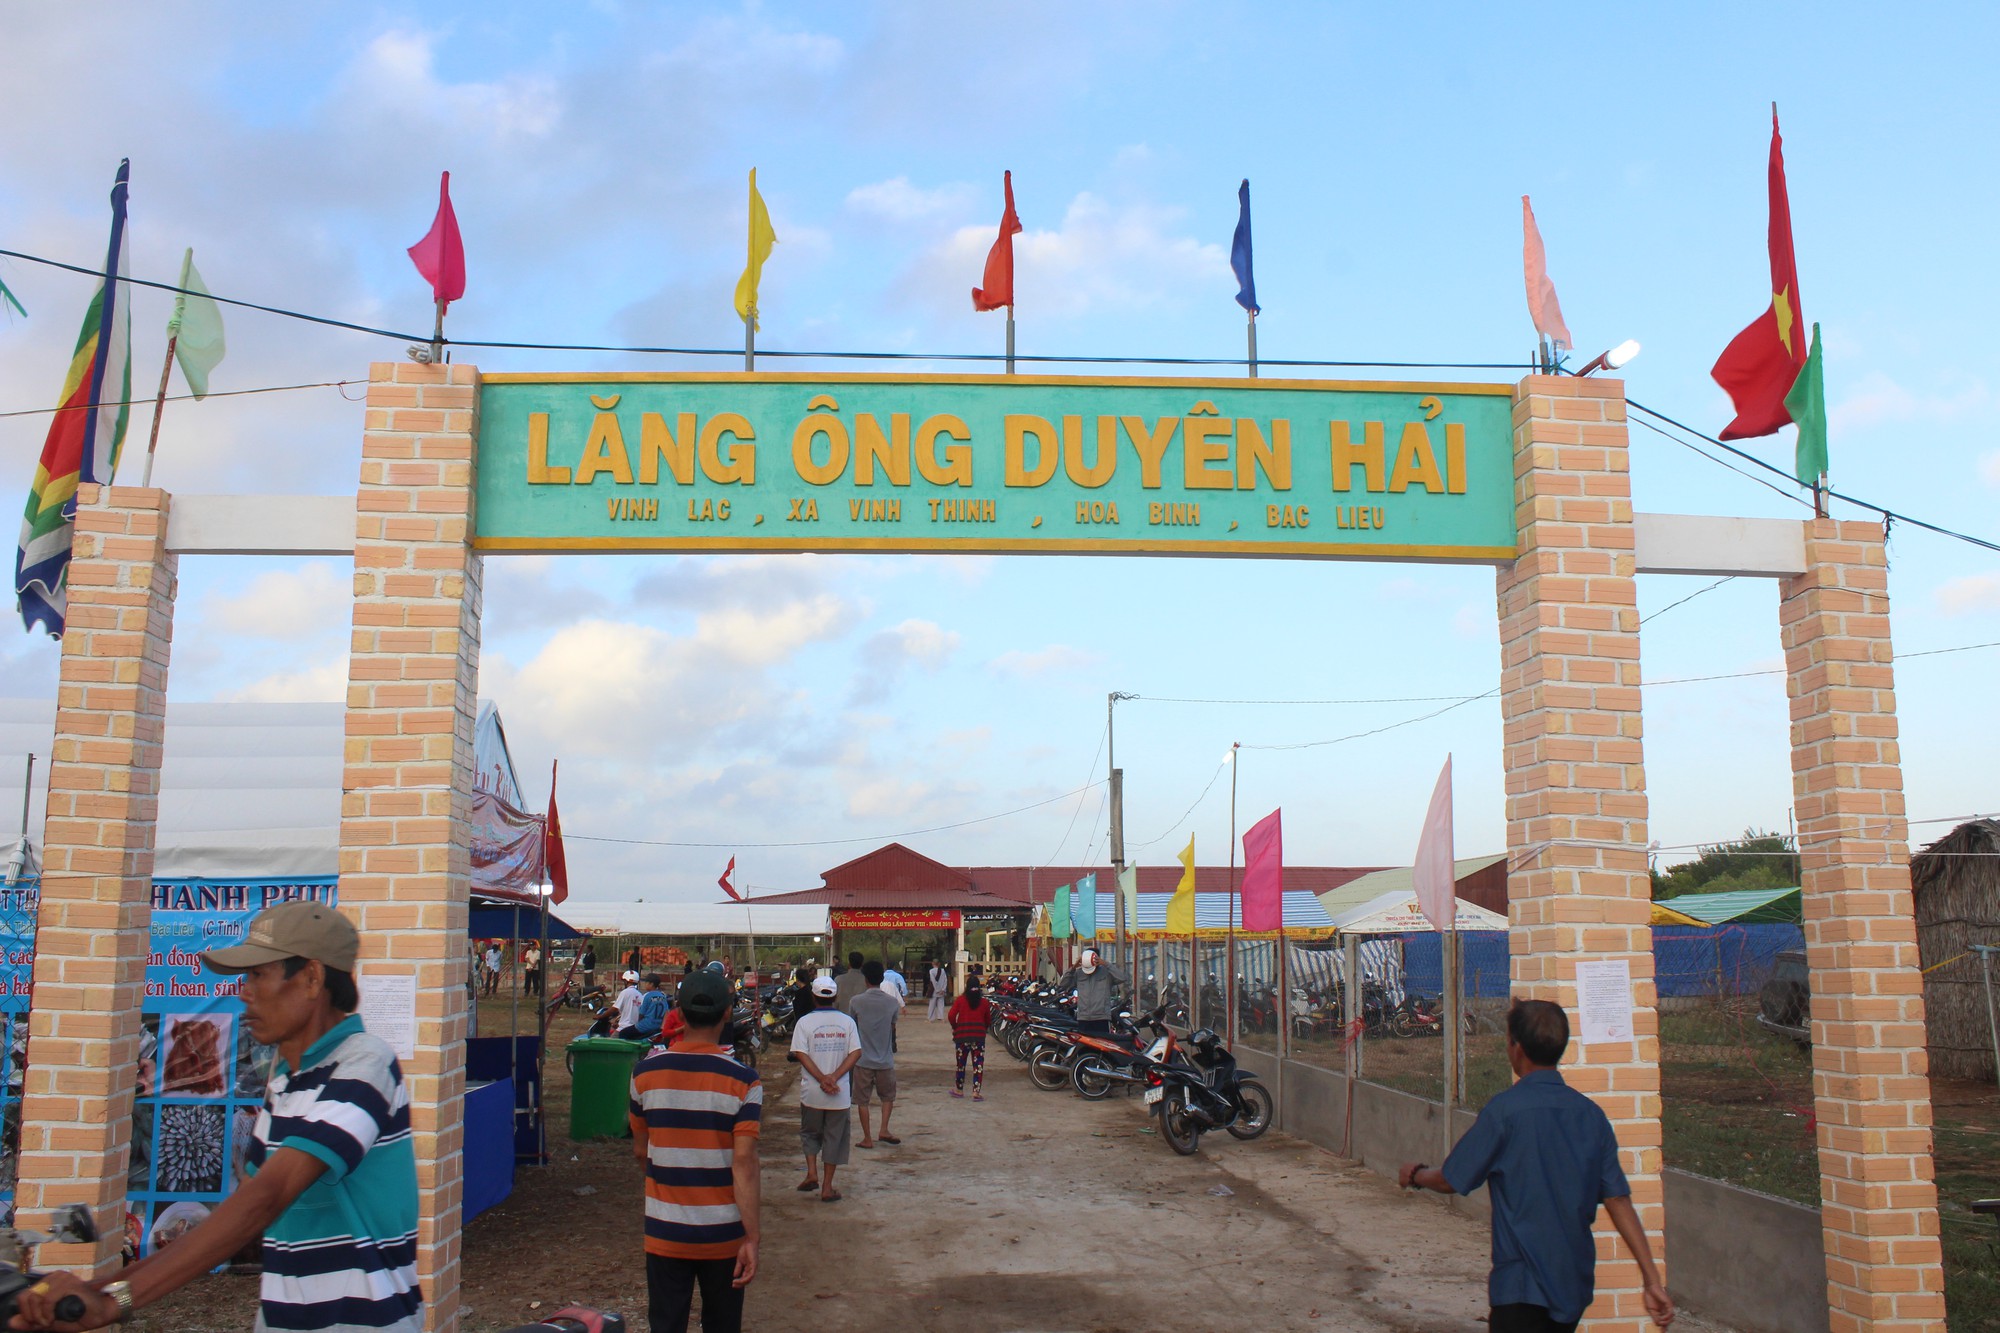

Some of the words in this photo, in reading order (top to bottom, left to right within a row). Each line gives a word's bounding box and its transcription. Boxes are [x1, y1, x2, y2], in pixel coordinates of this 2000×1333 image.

[527, 394, 756, 486] LĂNG
[792, 394, 973, 487] ÔNG
[1004, 400, 1292, 490] DUYÊN
[1330, 395, 1467, 494] HẢI
[606, 498, 659, 521] VINH
[688, 498, 732, 521] LAC
[787, 498, 819, 522] XA
[849, 498, 901, 522] VINH
[928, 498, 997, 522] THINH
[1074, 499, 1120, 524] HOA
[1148, 502, 1201, 527] BINH
[1266, 504, 1310, 528] BAC
[1336, 505, 1386, 530] LIEU
